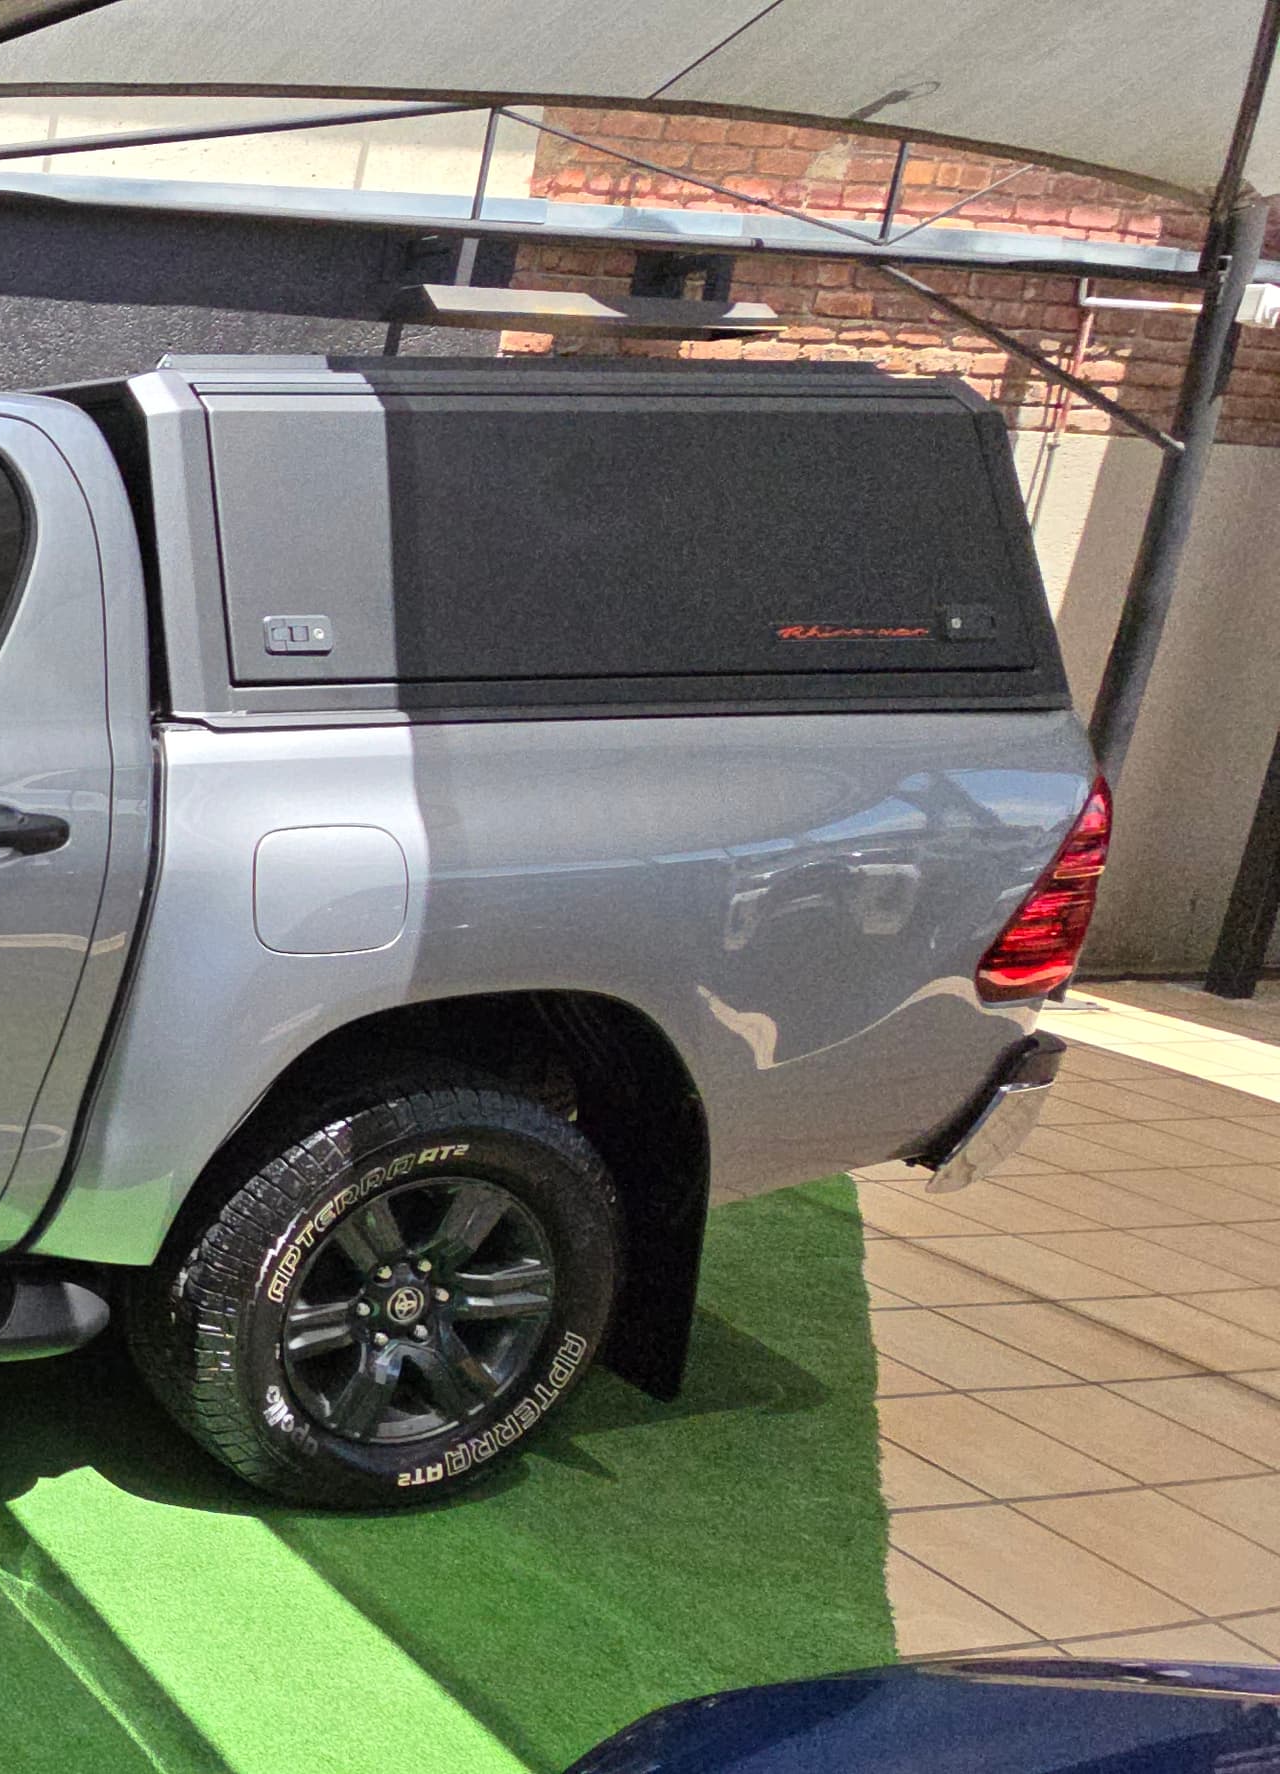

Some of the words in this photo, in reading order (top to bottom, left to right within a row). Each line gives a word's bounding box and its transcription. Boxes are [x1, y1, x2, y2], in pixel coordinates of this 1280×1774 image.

[267, 1153, 417, 1304] APTERRA
[417, 1143, 470, 1165] AT2
[397, 1462, 445, 1488] AT2
[444, 1330, 588, 1477] APTERRA
